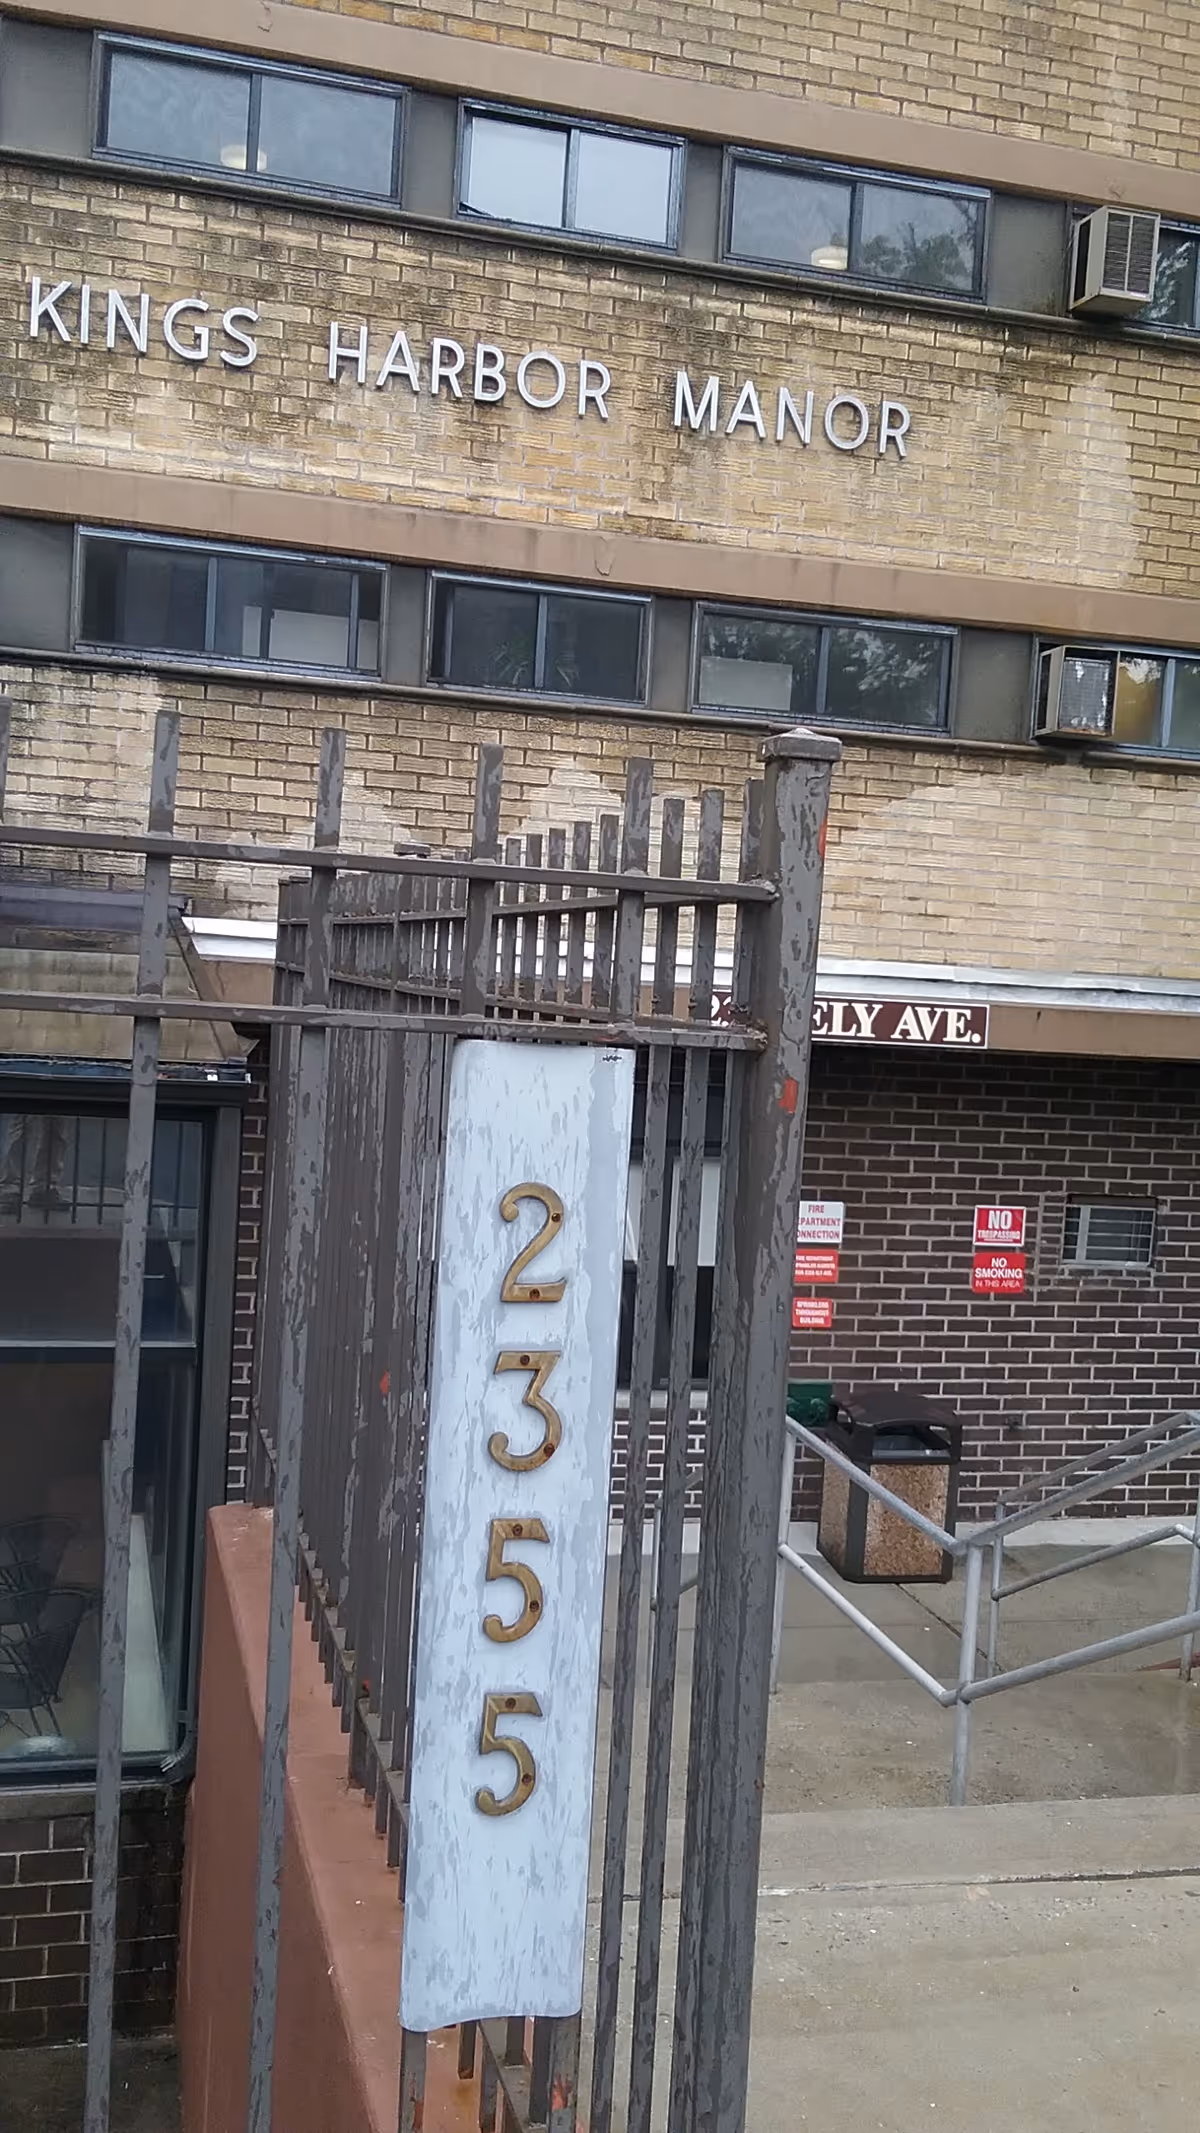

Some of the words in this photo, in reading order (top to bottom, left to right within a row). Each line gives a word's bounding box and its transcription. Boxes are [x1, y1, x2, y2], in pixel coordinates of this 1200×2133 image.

[28, 276, 260, 369] KINGS
[327, 321, 612, 421] HARBOR
[673, 370, 911, 460] MANOR
[890, 1004, 982, 1044] AVE.
[808, 1205, 824, 1213] FIRE
[799, 1217, 841, 1227] PARTMENT
[989, 1211, 1012, 1229] NO
[991, 1258, 1007, 1267] NO
[975, 1268, 1022, 1278] SMOKING
[975, 1279, 983, 1287] IN
[1001, 1280, 1021, 1288] AREA
[474, 1181, 567, 1817] 2355
